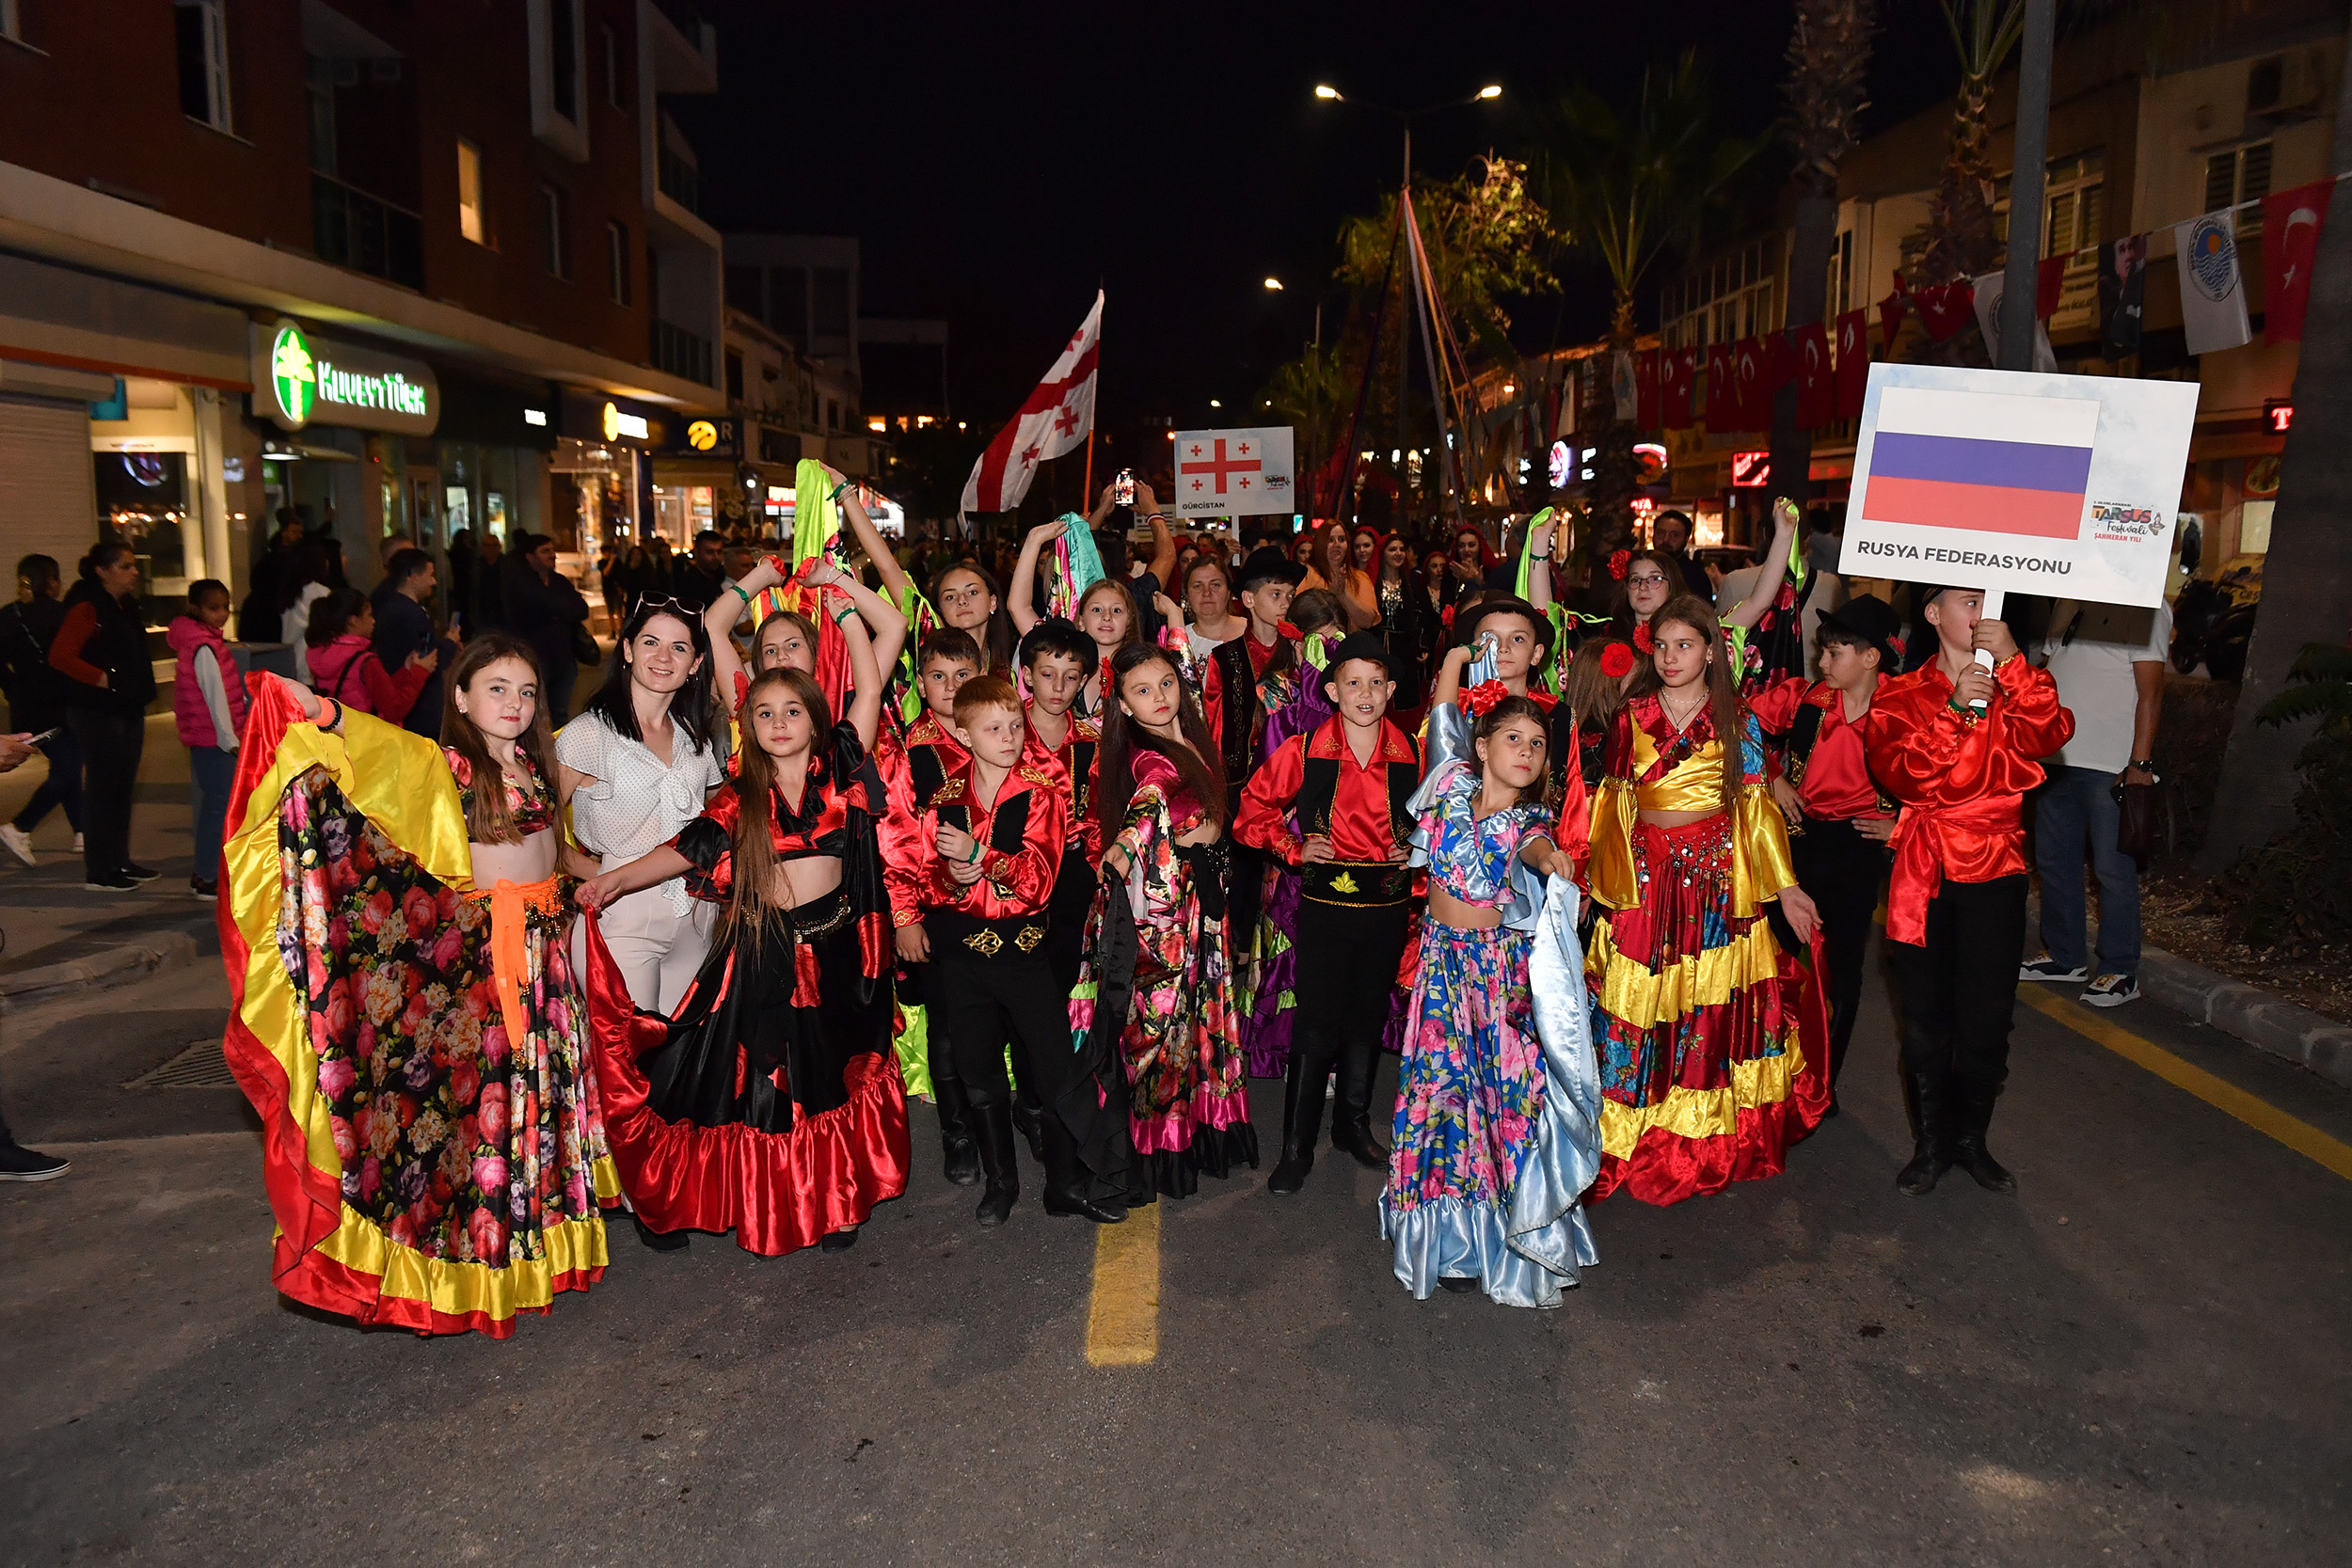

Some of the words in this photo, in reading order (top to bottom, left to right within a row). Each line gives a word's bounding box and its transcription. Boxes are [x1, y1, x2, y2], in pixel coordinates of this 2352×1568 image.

[1182, 500, 1225, 510] GÜRCİSTAN
[2091, 505, 2152, 523] TARSUS
[2106, 520, 2149, 535] Festivali
[2094, 532, 2128, 542] ŞAHMERAN
[1857, 540, 1919, 560] RUSYA
[1924, 547, 2072, 575] FEDERASYONU
